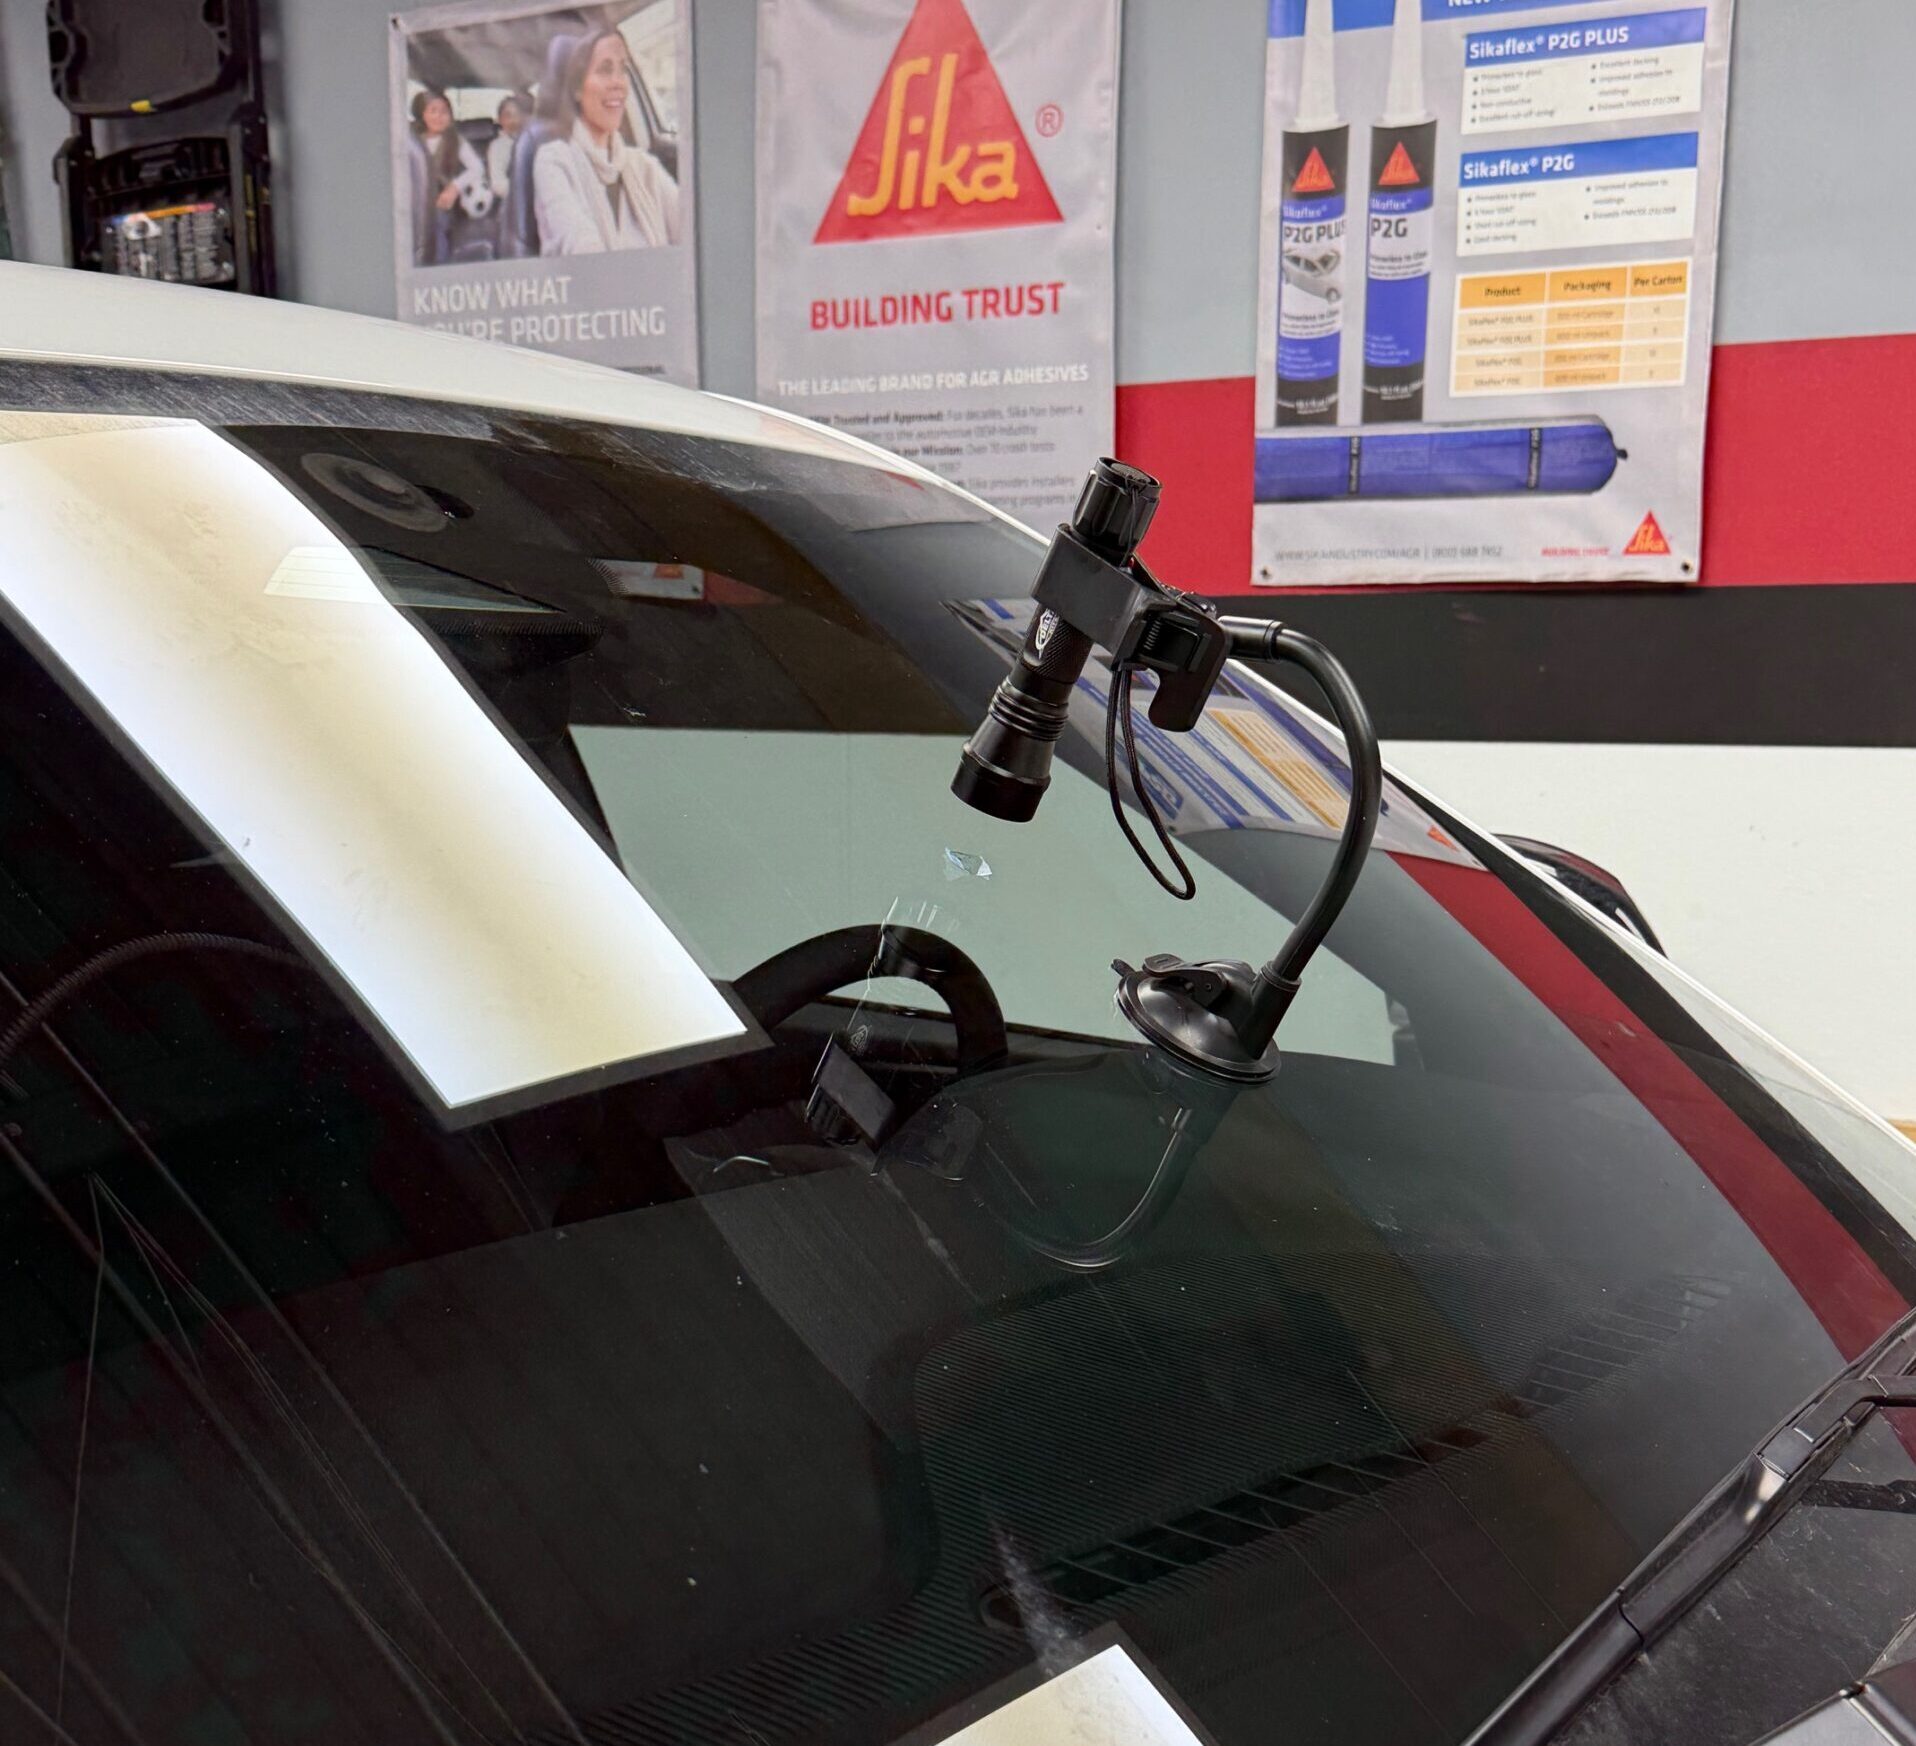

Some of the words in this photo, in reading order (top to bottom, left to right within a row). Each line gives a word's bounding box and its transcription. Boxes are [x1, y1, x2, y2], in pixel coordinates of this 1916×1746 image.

[1548, 32, 1580, 51] P2G
[1584, 26, 1629, 46] PLUS
[846, 53, 1019, 216] Sika
[1542, 154, 1575, 173] P2G
[1284, 226, 1313, 243] P2G
[1370, 218, 1408, 238] P2G
[414, 282, 490, 315] KNOW
[496, 276, 571, 307] WHAT
[1484, 286, 1521, 298] Product
[1563, 280, 1611, 293] Packaging
[810, 292, 952, 330] BUILDING
[962, 282, 1064, 320] TRUST
[510, 306, 666, 344] PROTECTING
[778, 379, 810, 396] THE
[812, 376, 877, 395] LEADING
[879, 373, 934, 392] BRAND
[936, 371, 967, 389] FOR
[1003, 364, 1089, 385] ADHESIVES
[1628, 524, 1665, 552] Sika
